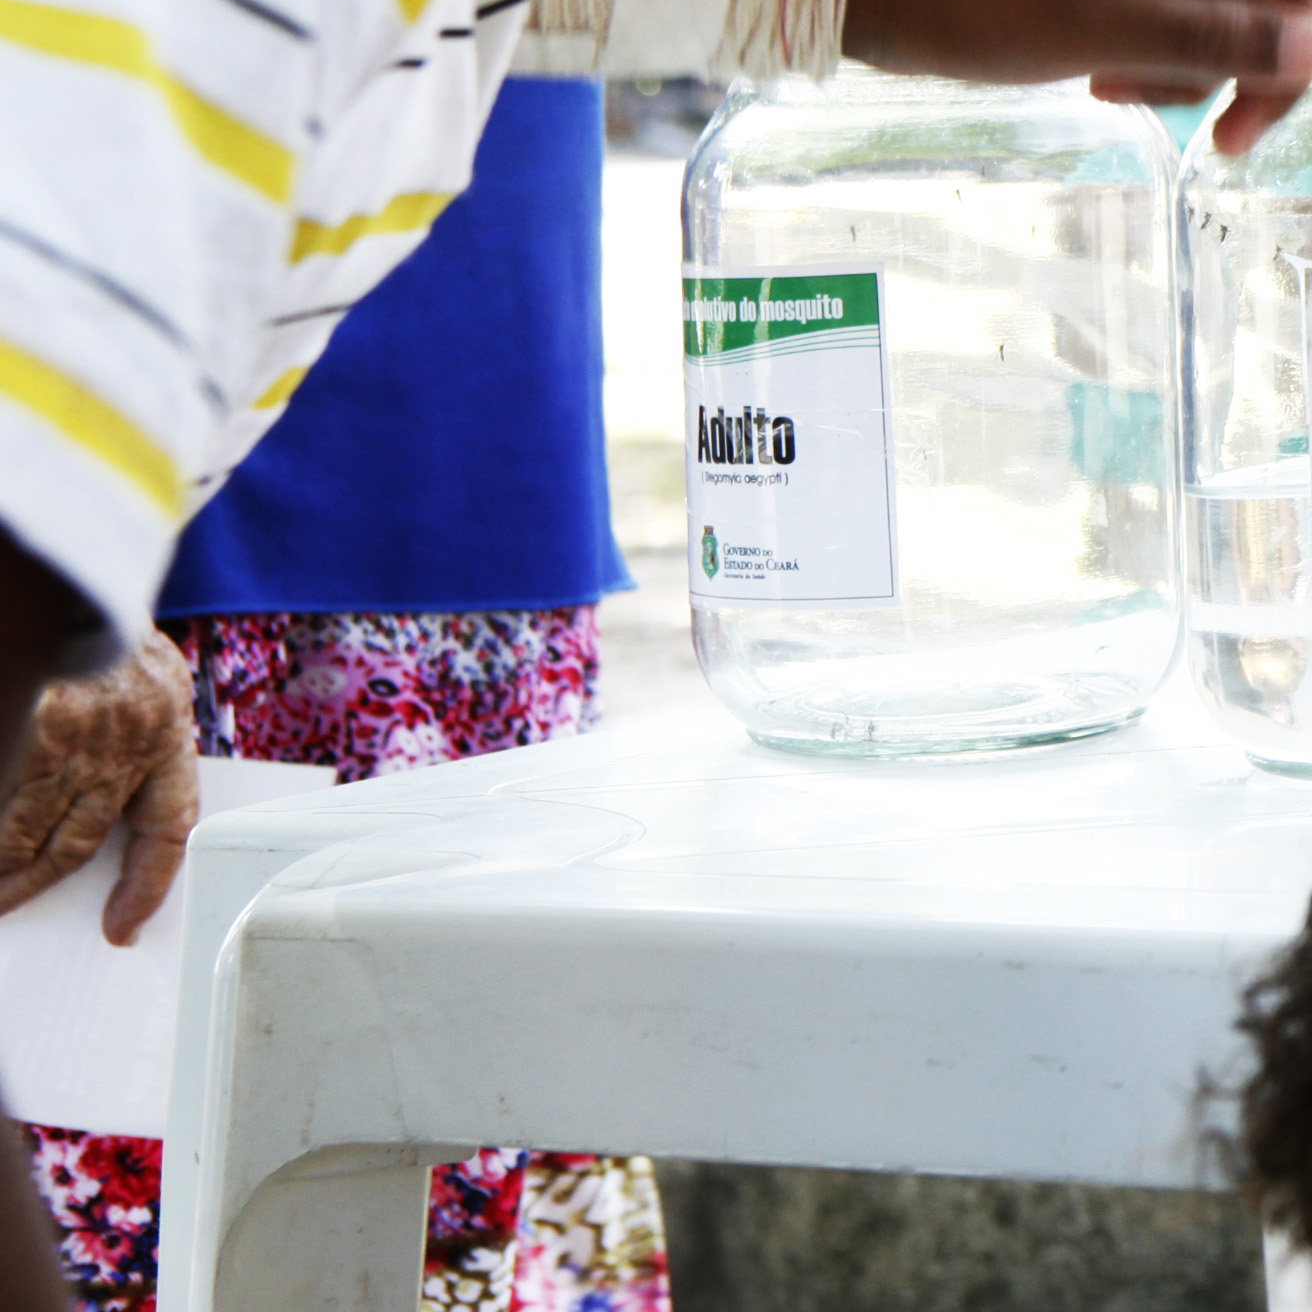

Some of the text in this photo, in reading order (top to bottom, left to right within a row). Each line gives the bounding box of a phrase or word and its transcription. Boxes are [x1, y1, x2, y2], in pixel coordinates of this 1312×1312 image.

[739, 296, 757, 322] do
[759, 293, 844, 324] mosquito
[697, 405, 796, 465] Adulto
